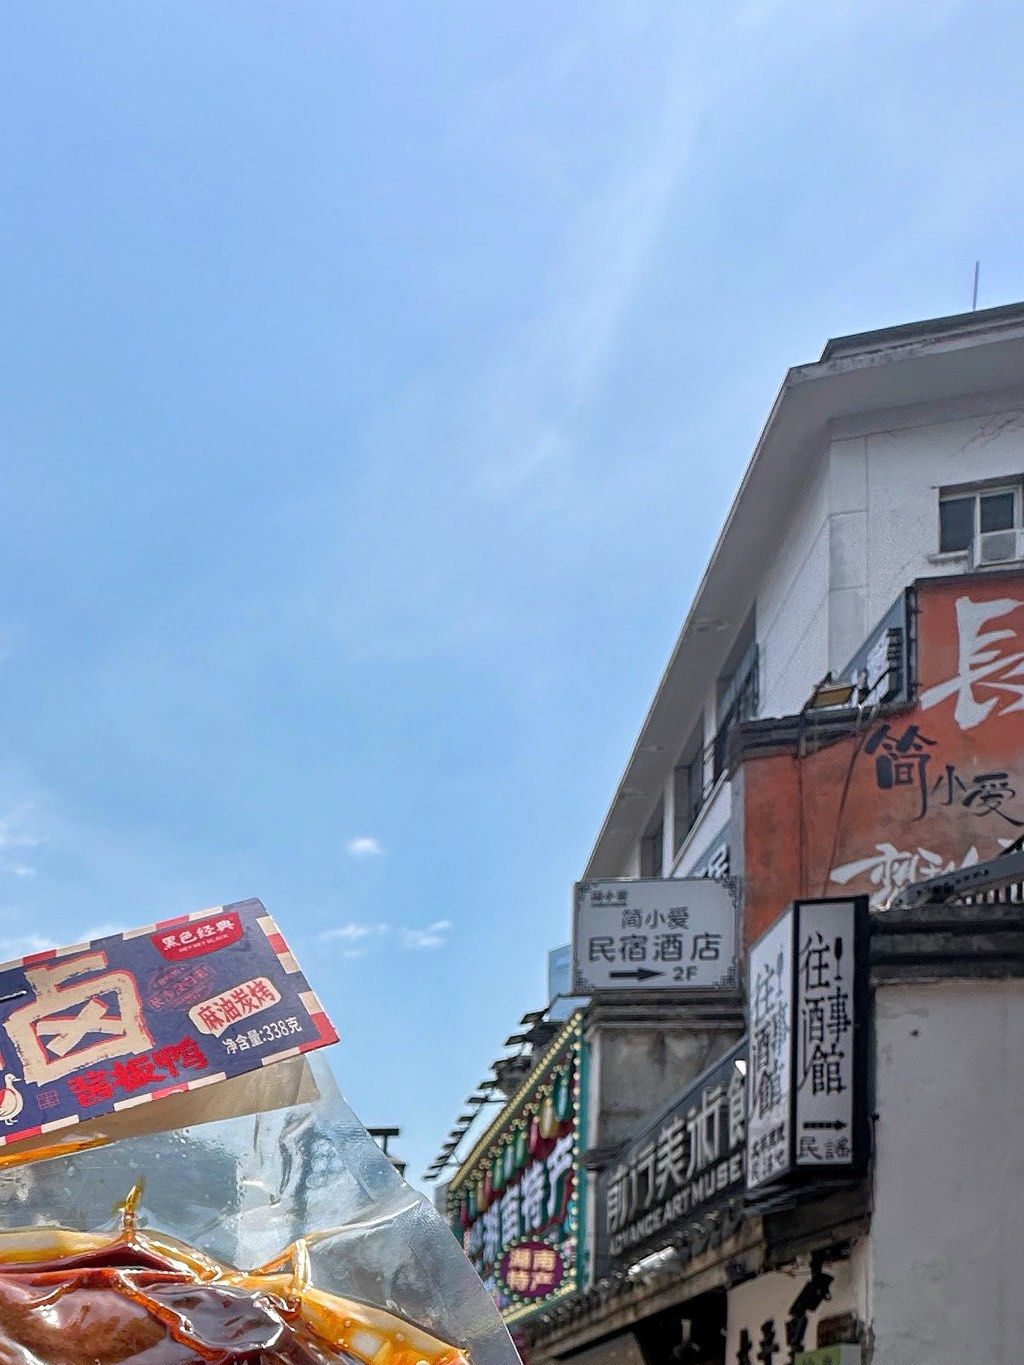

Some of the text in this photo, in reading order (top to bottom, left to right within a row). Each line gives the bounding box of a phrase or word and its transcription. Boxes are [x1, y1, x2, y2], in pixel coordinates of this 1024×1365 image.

[620, 905, 690, 930] 简小爱
[161, 918, 235, 950] 黑色经典
[588, 932, 722, 963] 民宿酒店
[672, 965, 699, 982] 2F
[196, 980, 276, 1030] 麻油炭烤
